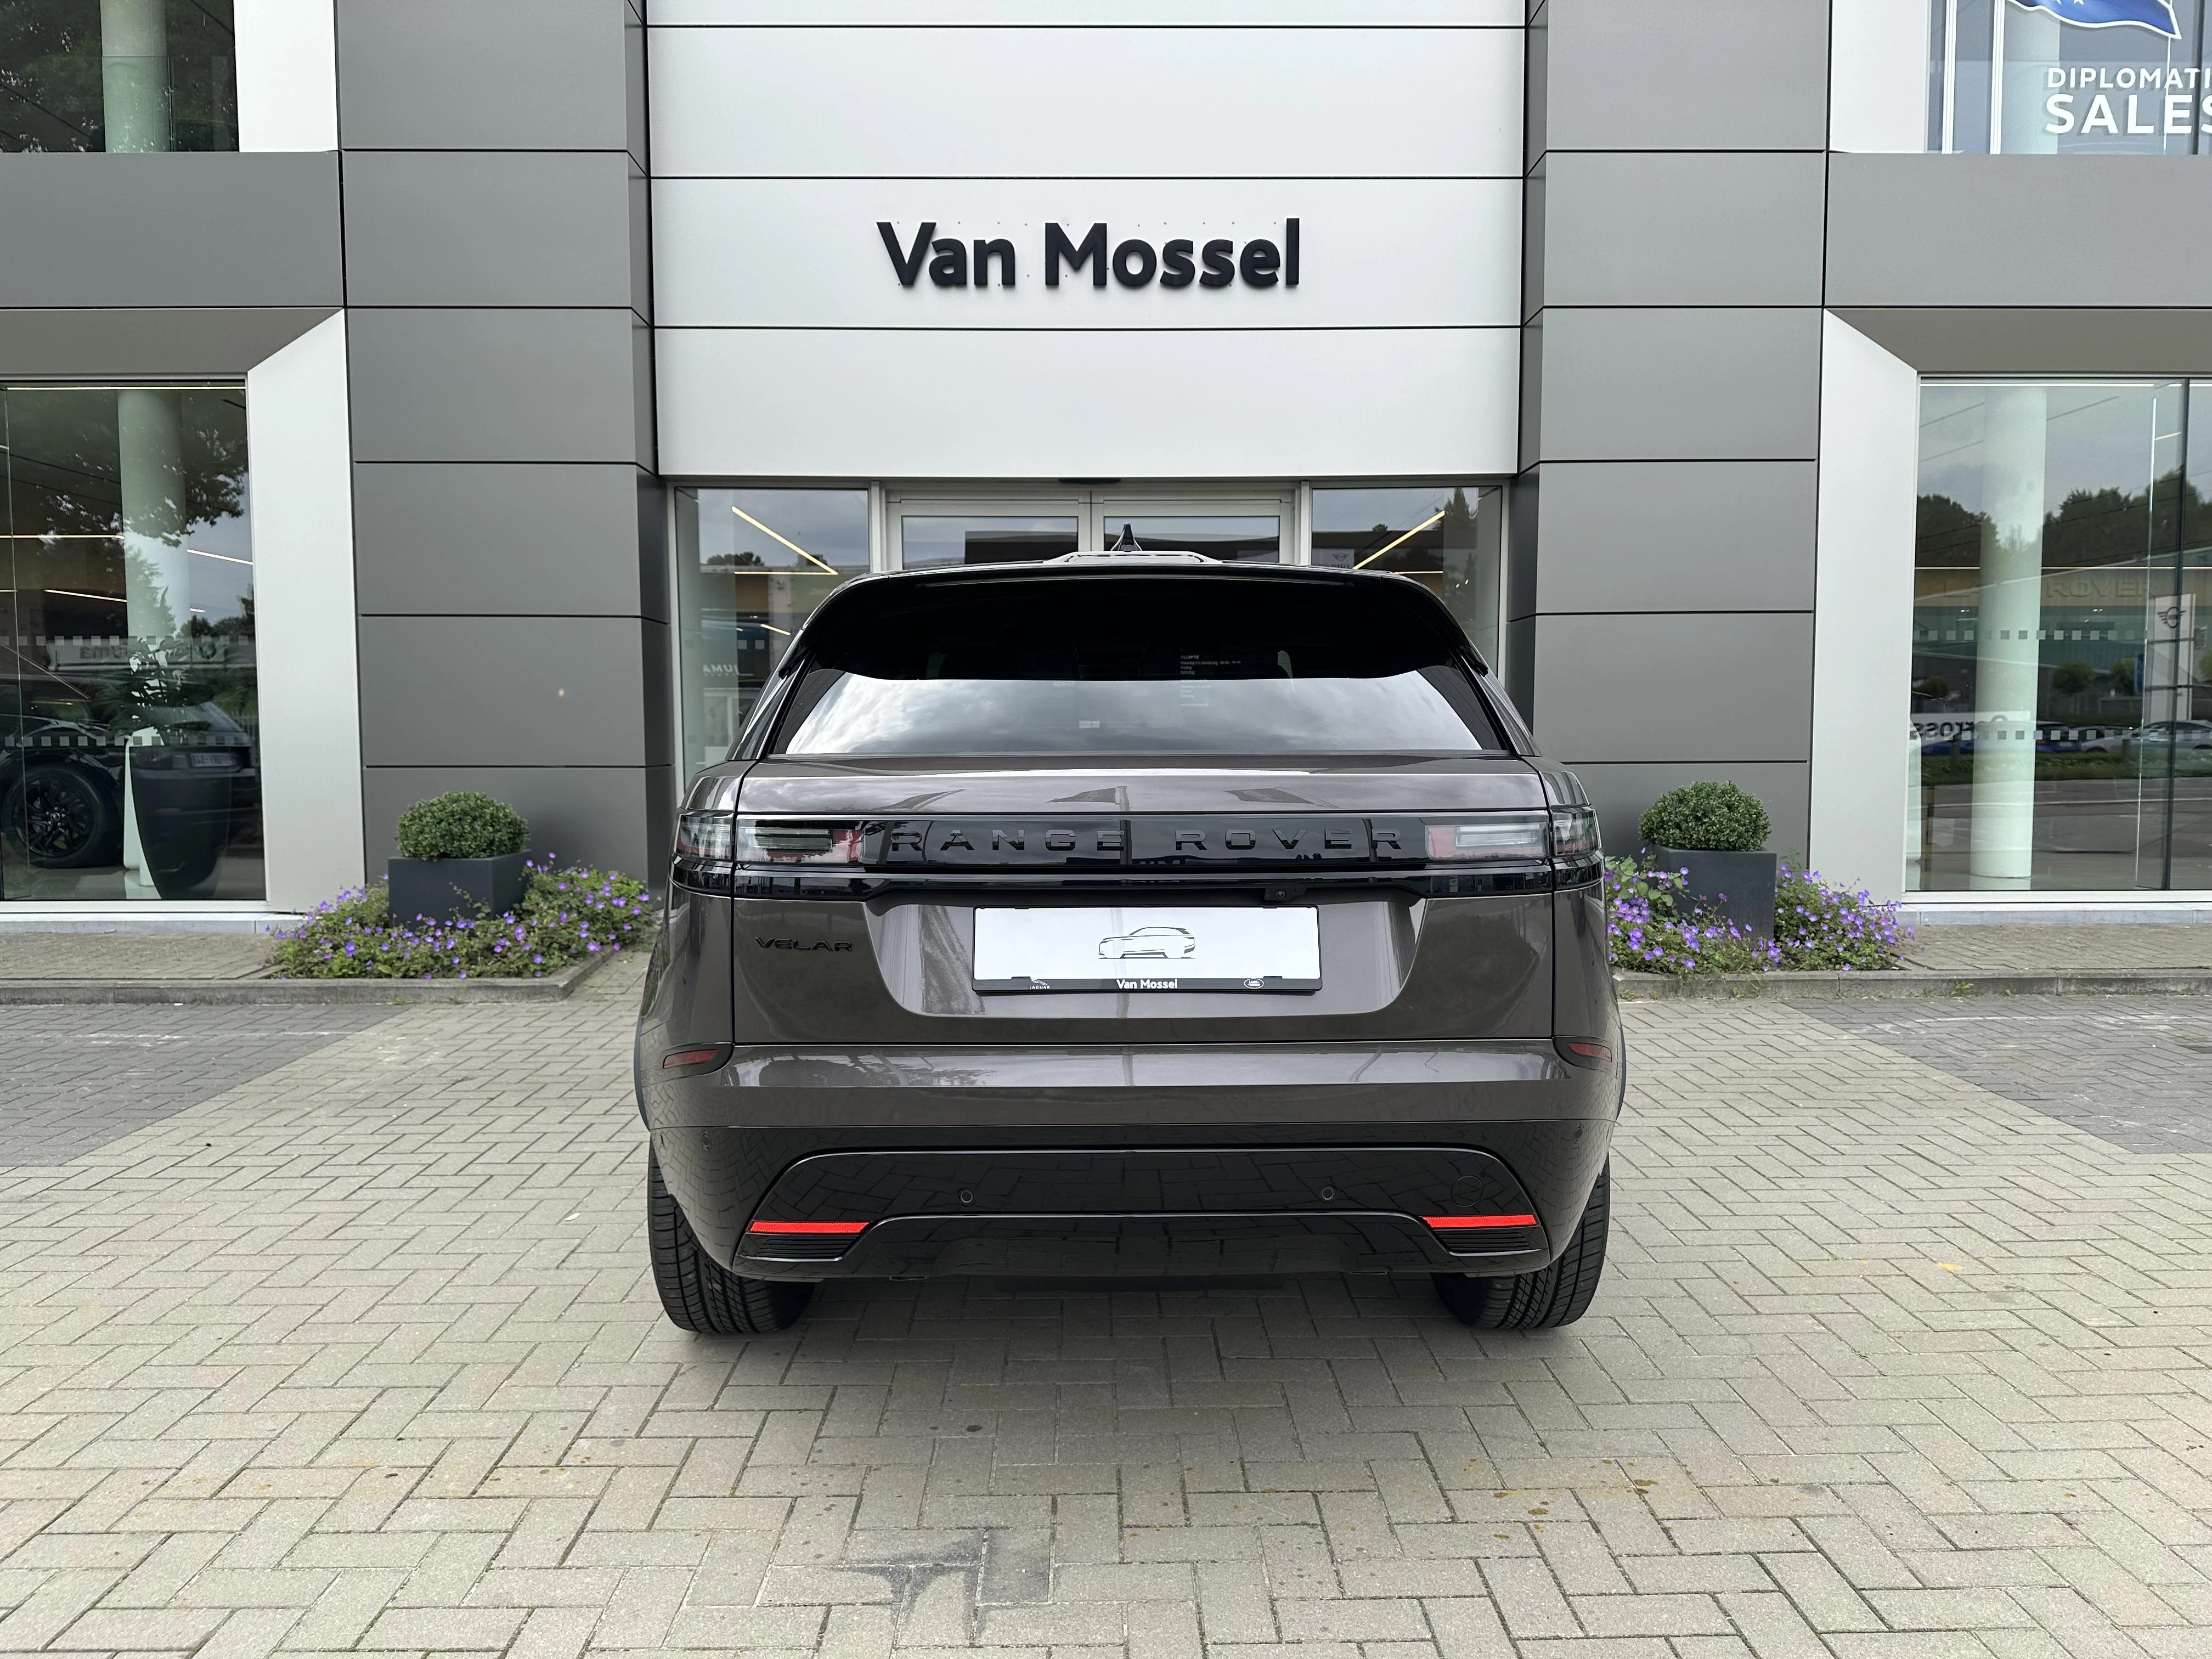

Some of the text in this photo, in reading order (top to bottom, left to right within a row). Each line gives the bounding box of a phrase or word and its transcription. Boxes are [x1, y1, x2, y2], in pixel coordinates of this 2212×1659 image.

[2047, 67, 2211, 88] DIPLOMATI
[877, 217, 1300, 287] Van Mossel
[891, 828, 1402, 851] RANGE ROVER
[755, 936, 853, 952] VELAR
[1116, 978, 1178, 989] Van Mossel
